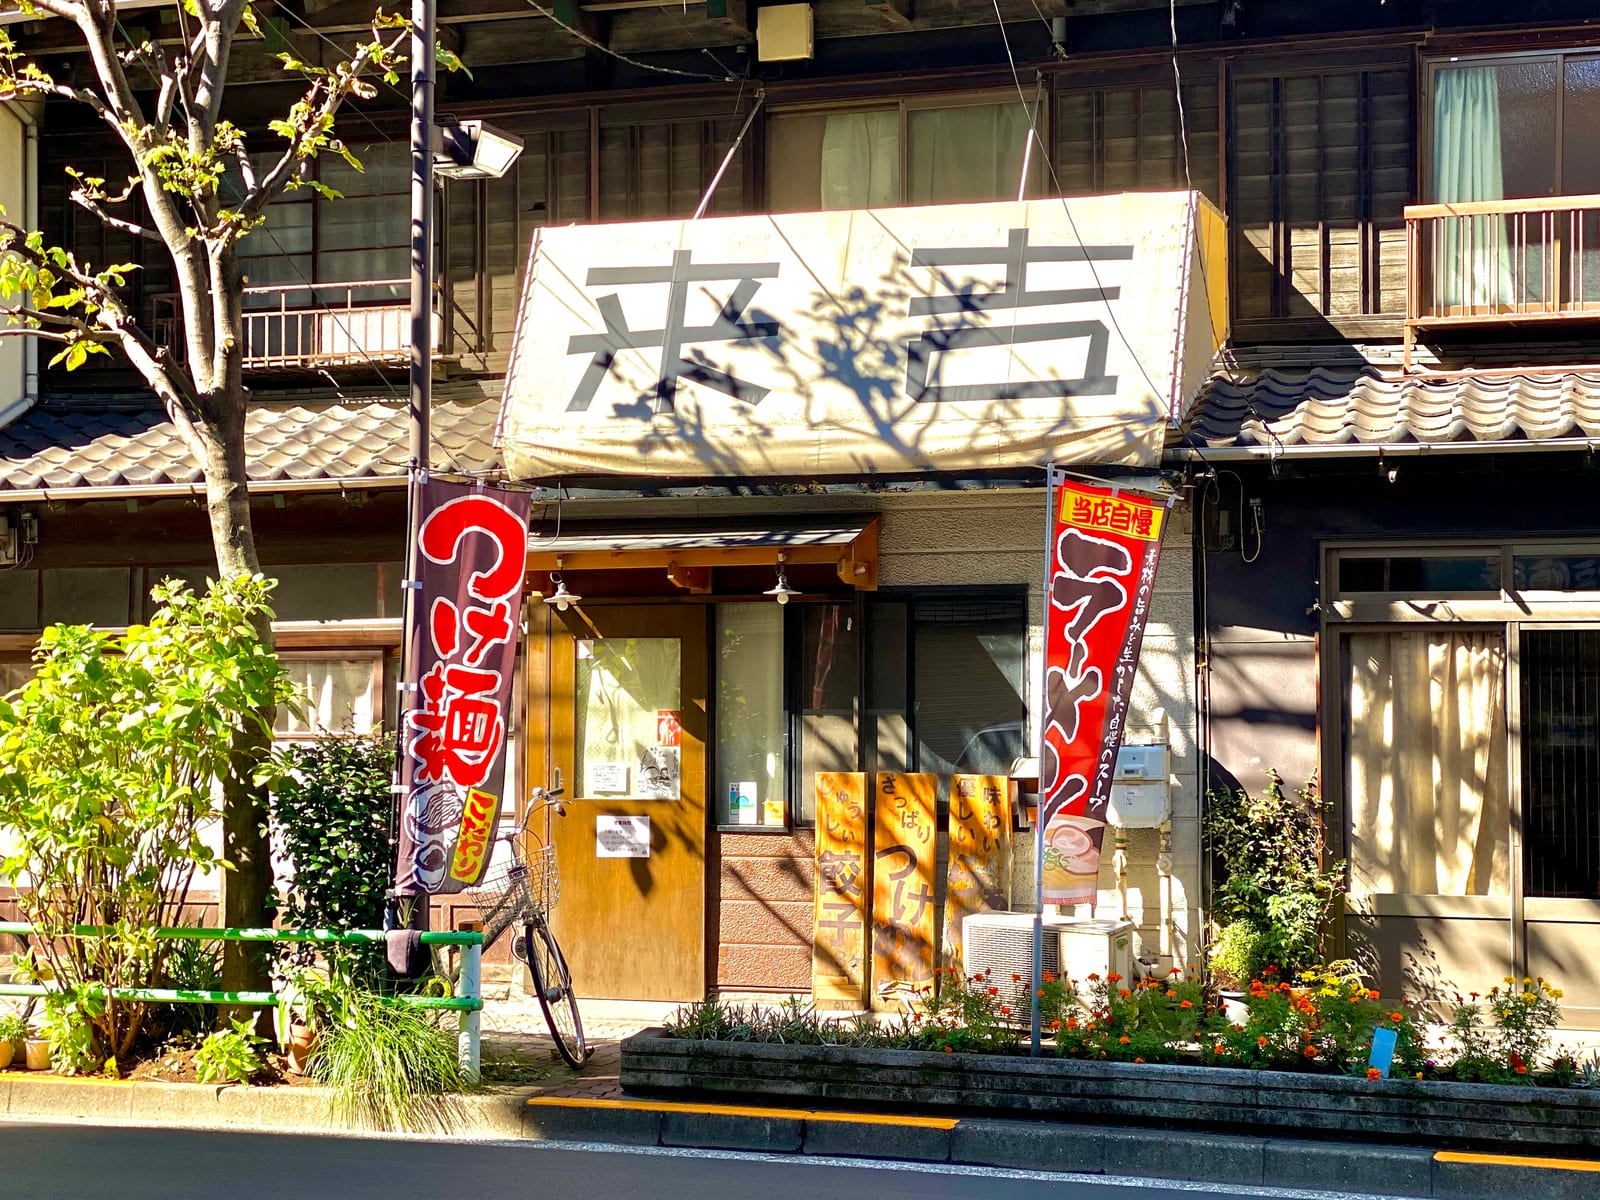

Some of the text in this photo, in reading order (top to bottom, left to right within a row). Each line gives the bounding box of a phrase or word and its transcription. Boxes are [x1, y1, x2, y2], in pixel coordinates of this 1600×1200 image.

[1072, 496, 1153, 536] 当店自慢
[410, 495, 527, 787] つけ麺
[1043, 528, 1132, 830] ラーメン
[455, 793, 494, 877] こだわり
[881, 777, 931, 843] さっぱり
[956, 778, 976, 842] 優しい
[983, 786, 1001, 853] 味わい
[818, 850, 862, 947] 餃子
[874, 845, 934, 981] つけめん
